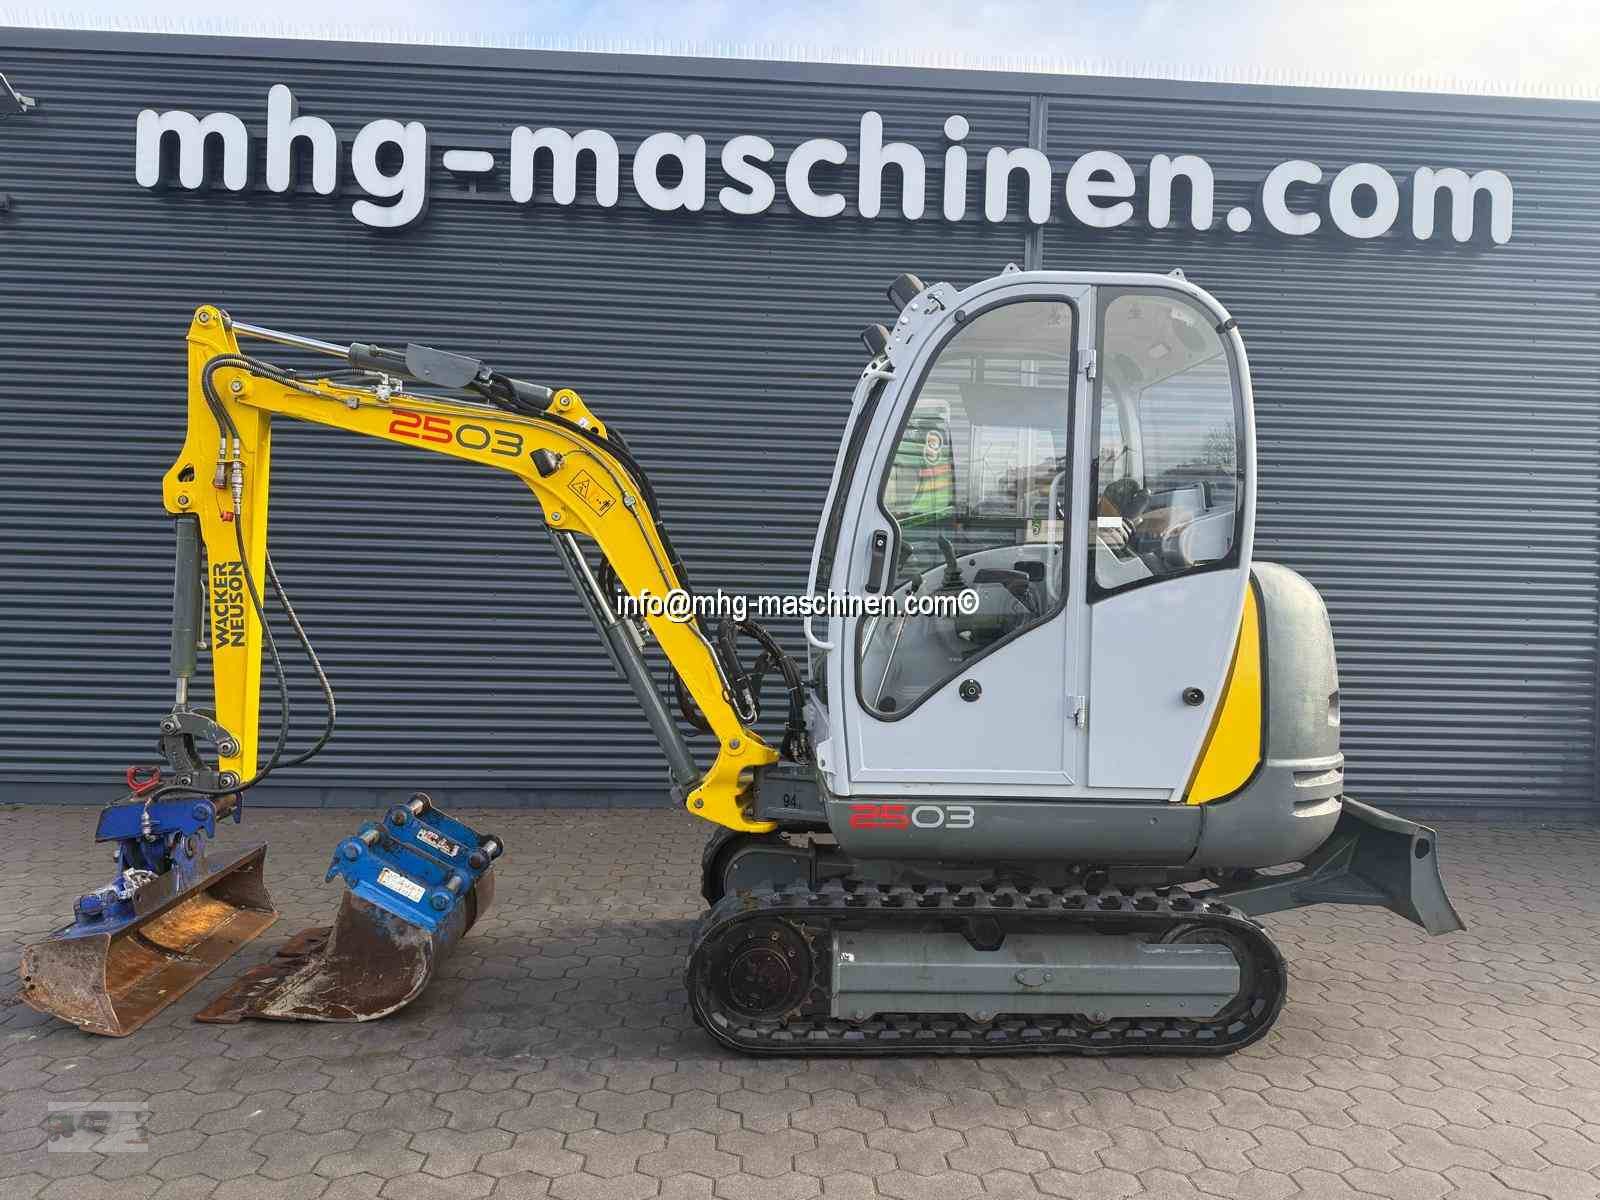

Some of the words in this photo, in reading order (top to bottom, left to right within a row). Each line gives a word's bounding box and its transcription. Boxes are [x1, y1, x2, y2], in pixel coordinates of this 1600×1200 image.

[135, 84, 1514, 245] mhg-maschinen.com
[389, 409, 524, 457] 2503
[213, 563, 230, 650] WACKER
[228, 561, 245, 647] NEUSON
[849, 803, 975, 830] 2503
